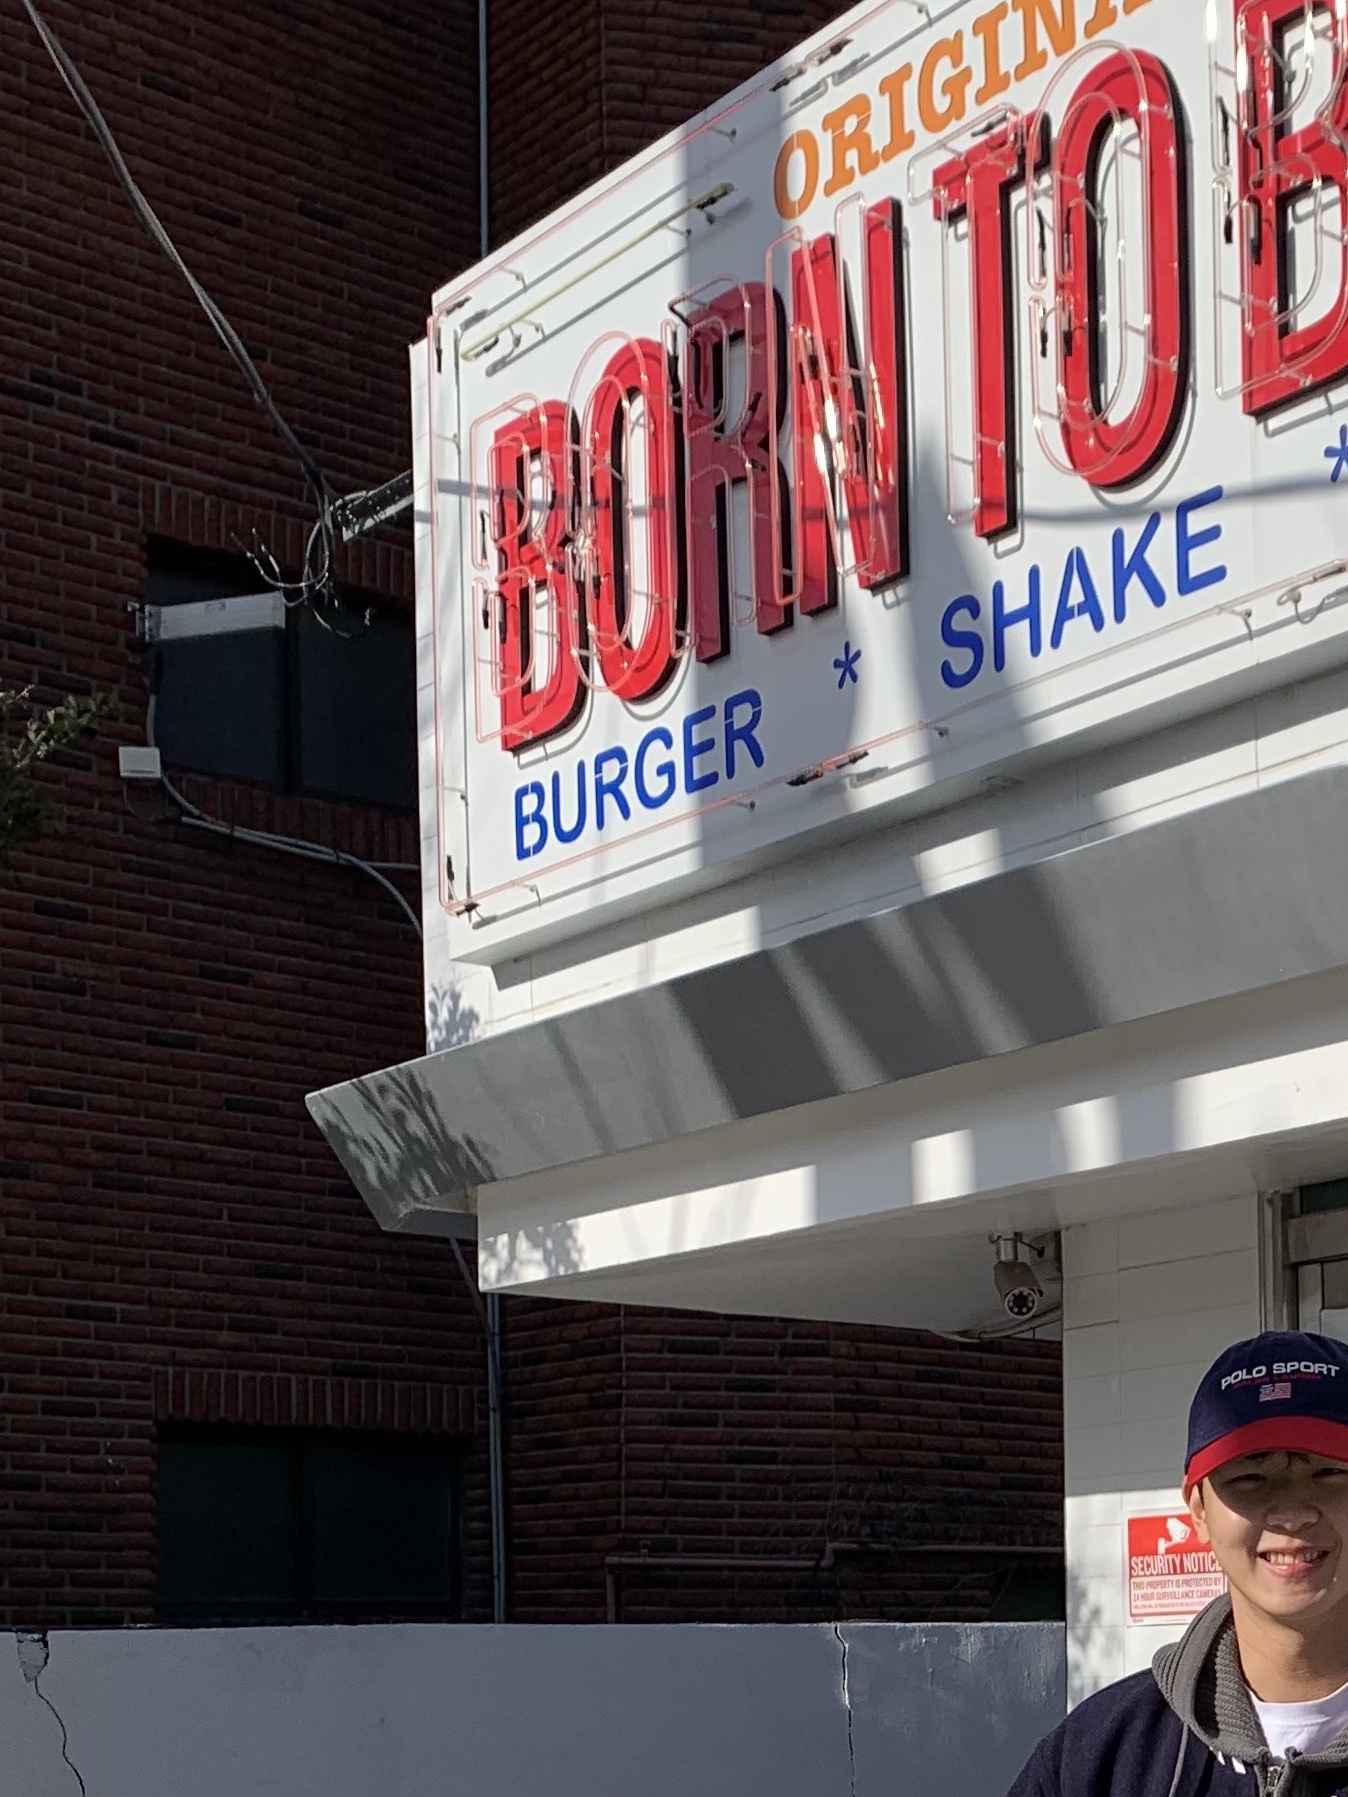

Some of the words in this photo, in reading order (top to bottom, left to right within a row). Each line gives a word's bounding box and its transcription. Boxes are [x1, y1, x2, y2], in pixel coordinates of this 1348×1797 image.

[490, 196, 909, 751] BORN
[932, 47, 1190, 540] TO
[514, 687, 766, 861] BURGER
[940, 484, 1228, 690] SHAKE
[1221, 1365, 1267, 1390] POLO
[1272, 1361, 1340, 1377] SPORT
[1131, 1553, 1180, 1576] SECURITY
[1133, 1593, 1140, 1602] 24
[1140, 1592, 1155, 1601] HOUR
[1155, 1590, 1195, 1600] SURVEILLANCE
[1145, 1579, 1175, 1589] PROPERTY
[1175, 1579, 1181, 1588] IS
[1181, 1577, 1213, 1587] PROTECTED
